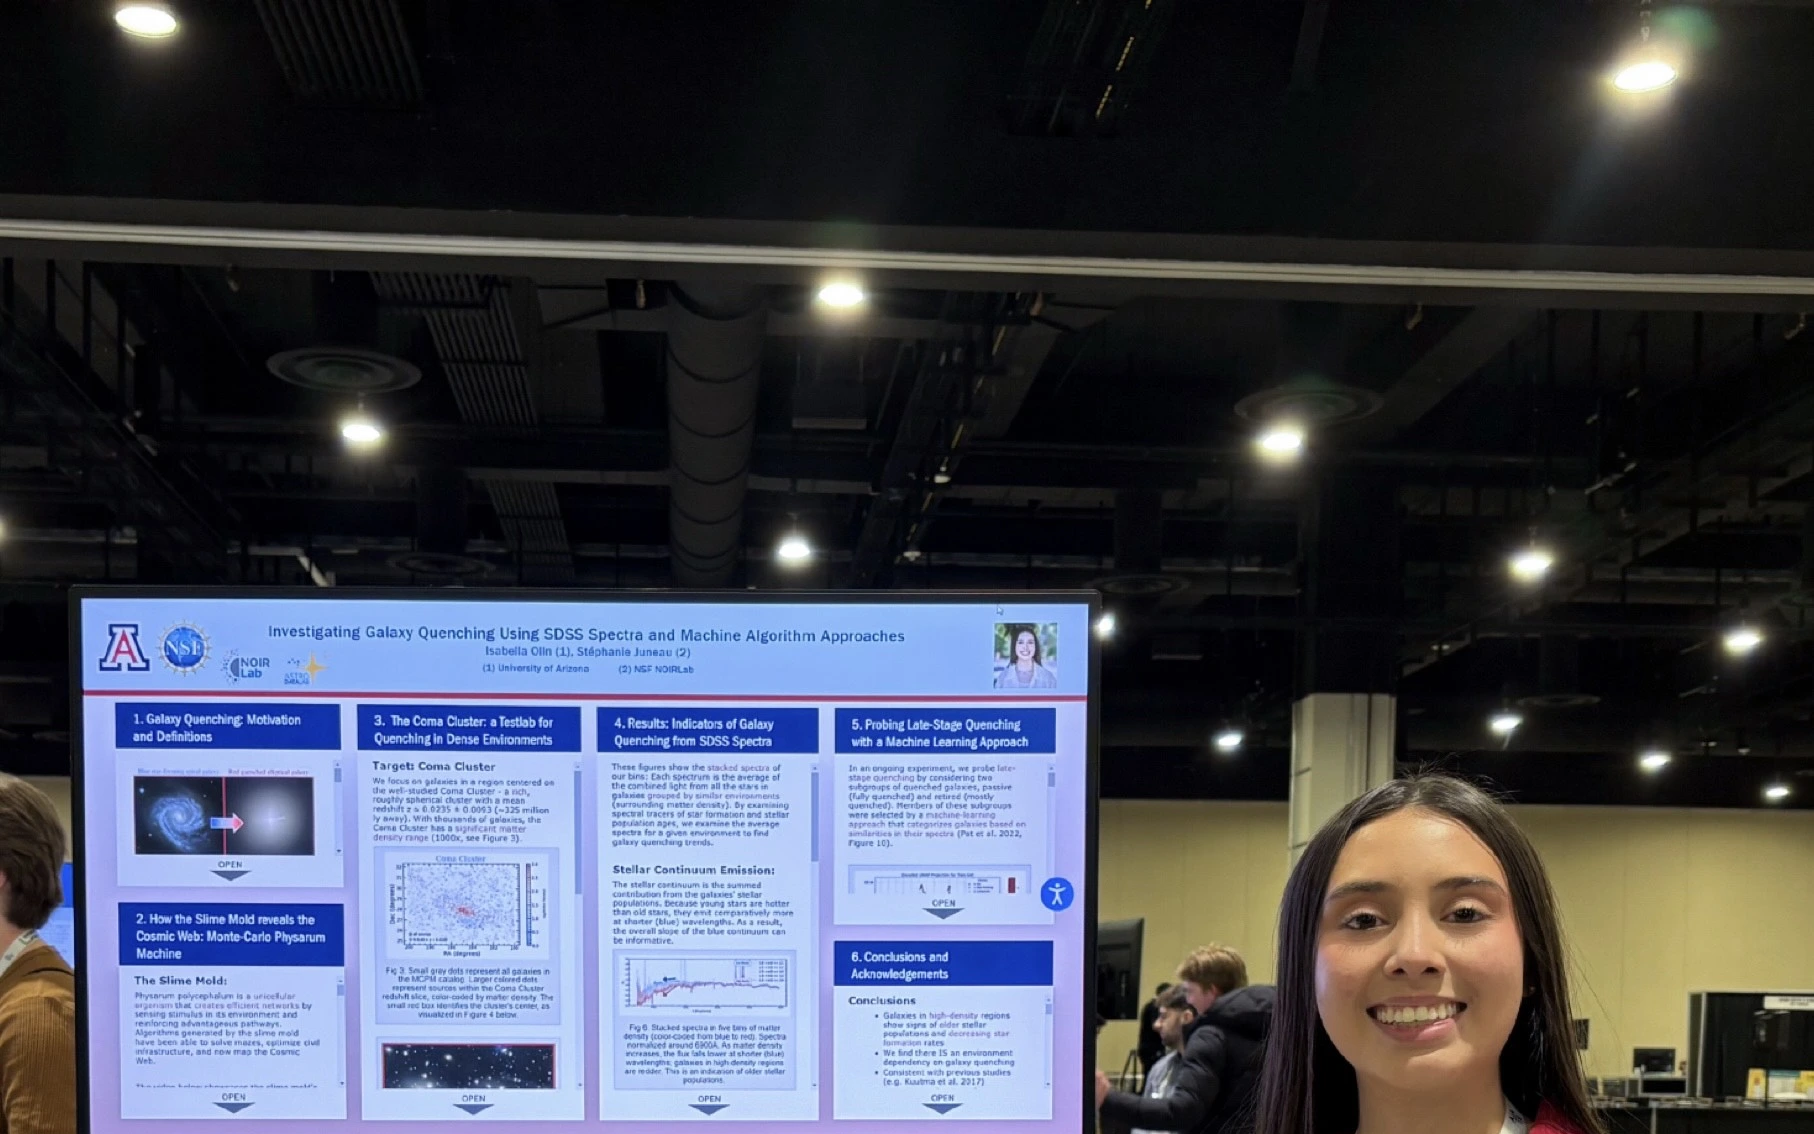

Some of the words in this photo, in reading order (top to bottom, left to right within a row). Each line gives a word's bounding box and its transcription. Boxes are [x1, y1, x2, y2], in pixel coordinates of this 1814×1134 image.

[269, 626, 360, 640] Investigating
[366, 626, 413, 640] Galaxy
[418, 627, 495, 641] Quenching
[500, 628, 539, 641] Using
[544, 628, 584, 640] SDSS
[589, 629, 643, 642] Spectra
[648, 629, 675, 641] and
[681, 630, 741, 642] Machine
[746, 630, 815, 644] Algorithm
[820, 630, 905, 644] Approaches
[486, 646, 527, 656] Isabella
[531, 647, 552, 657] Olin
[634, 648, 672, 657] Juneau
[676, 648, 691, 658] (2)
[241, 658, 269, 667] NOIR
[241, 669, 262, 678] Lab
[482, 663, 495, 672] (1)
[498, 663, 541, 673] University
[544, 664, 553, 672] of
[557, 664, 589, 673] Arizona
[619, 665, 632, 674] (2)
[634, 665, 652, 673] NSF
[655, 665, 694, 674] NOIRLab
[134, 714, 144, 725] 1.
[146, 714, 181, 727] Galaxy
[184, 715, 243, 728] Quenching:
[247, 715, 301, 725] Motivation
[374, 716, 385, 726] 3.
[391, 715, 410, 726] The
[413, 715, 443, 727] Coma
[447, 716, 486, 727] Cluster:
[490, 719, 497, 727] a
[500, 716, 536, 728] Testlab
[539, 717, 553, 728] for
[615, 718, 625, 729] 4.
[628, 718, 669, 729] Results:
[673, 719, 723, 729] Indicators
[726, 719, 737, 729] of
[739, 719, 774, 731] Galaxy
[852, 719, 862, 730] 5.
[865, 719, 905, 731] Probing
[907, 719, 962, 731] Late-Stage
[965, 719, 1021, 731] Quenching
[133, 732, 152, 741] and
[157, 731, 212, 742] Definitions
[374, 733, 431, 746] Quenching
[434, 734, 443, 744] in
[447, 734, 479, 745] Dense
[483, 735, 553, 746] Environments
[615, 736, 671, 749] Quenching
[673, 736, 695, 746] from
[700, 736, 730, 746] SDSS
[732, 736, 772, 749] Spectra
[852, 737, 872, 746] with
[886, 737, 930, 747] Machine
[933, 737, 978, 749] Learning
[980, 737, 1029, 749] Approach
[373, 761, 414, 772] Target:
[419, 762, 450, 771] Coma
[455, 762, 495, 772] Cluster
[638, 764, 666, 772] figures
[741, 765, 770, 773] spectra
[673, 773, 710, 782] spectrum
[722, 773, 735, 781] the
[738, 774, 769, 782] average
[613, 865, 651, 874] Stellar
[654, 865, 716, 874] Continuum
[720, 866, 775, 876] Emission:
[136, 914, 146, 924] 2.
[149, 914, 172, 924] How
[175, 914, 192, 924] the
[196, 914, 226, 925] Slime
[228, 914, 254, 925] Mold
[258, 915, 295, 925] reveals
[298, 915, 315, 925] the
[136, 931, 175, 941] Cosmic
[178, 931, 204, 941] Web:
[207, 931, 271, 942] Monte-Carlo
[274, 932, 325, 945] Physarum
[136, 949, 182, 959] Machine
[851, 952, 862, 962] 6.
[864, 952, 926, 962] Conclusions
[929, 953, 949, 962] and
[135, 976, 155, 985] The
[160, 976, 192, 985] Slime
[196, 977, 227, 985] Mold:
[851, 969, 949, 981] Acknowledgements
[848, 997, 916, 1005] Conclusions
[883, 1012, 916, 1020] Galaxies
[929, 1012, 978, 1021] high-density
[981, 1013, 1010, 1021] regions
[906, 1021, 926, 1030] signs
[222, 1093, 245, 1101] OPEN
